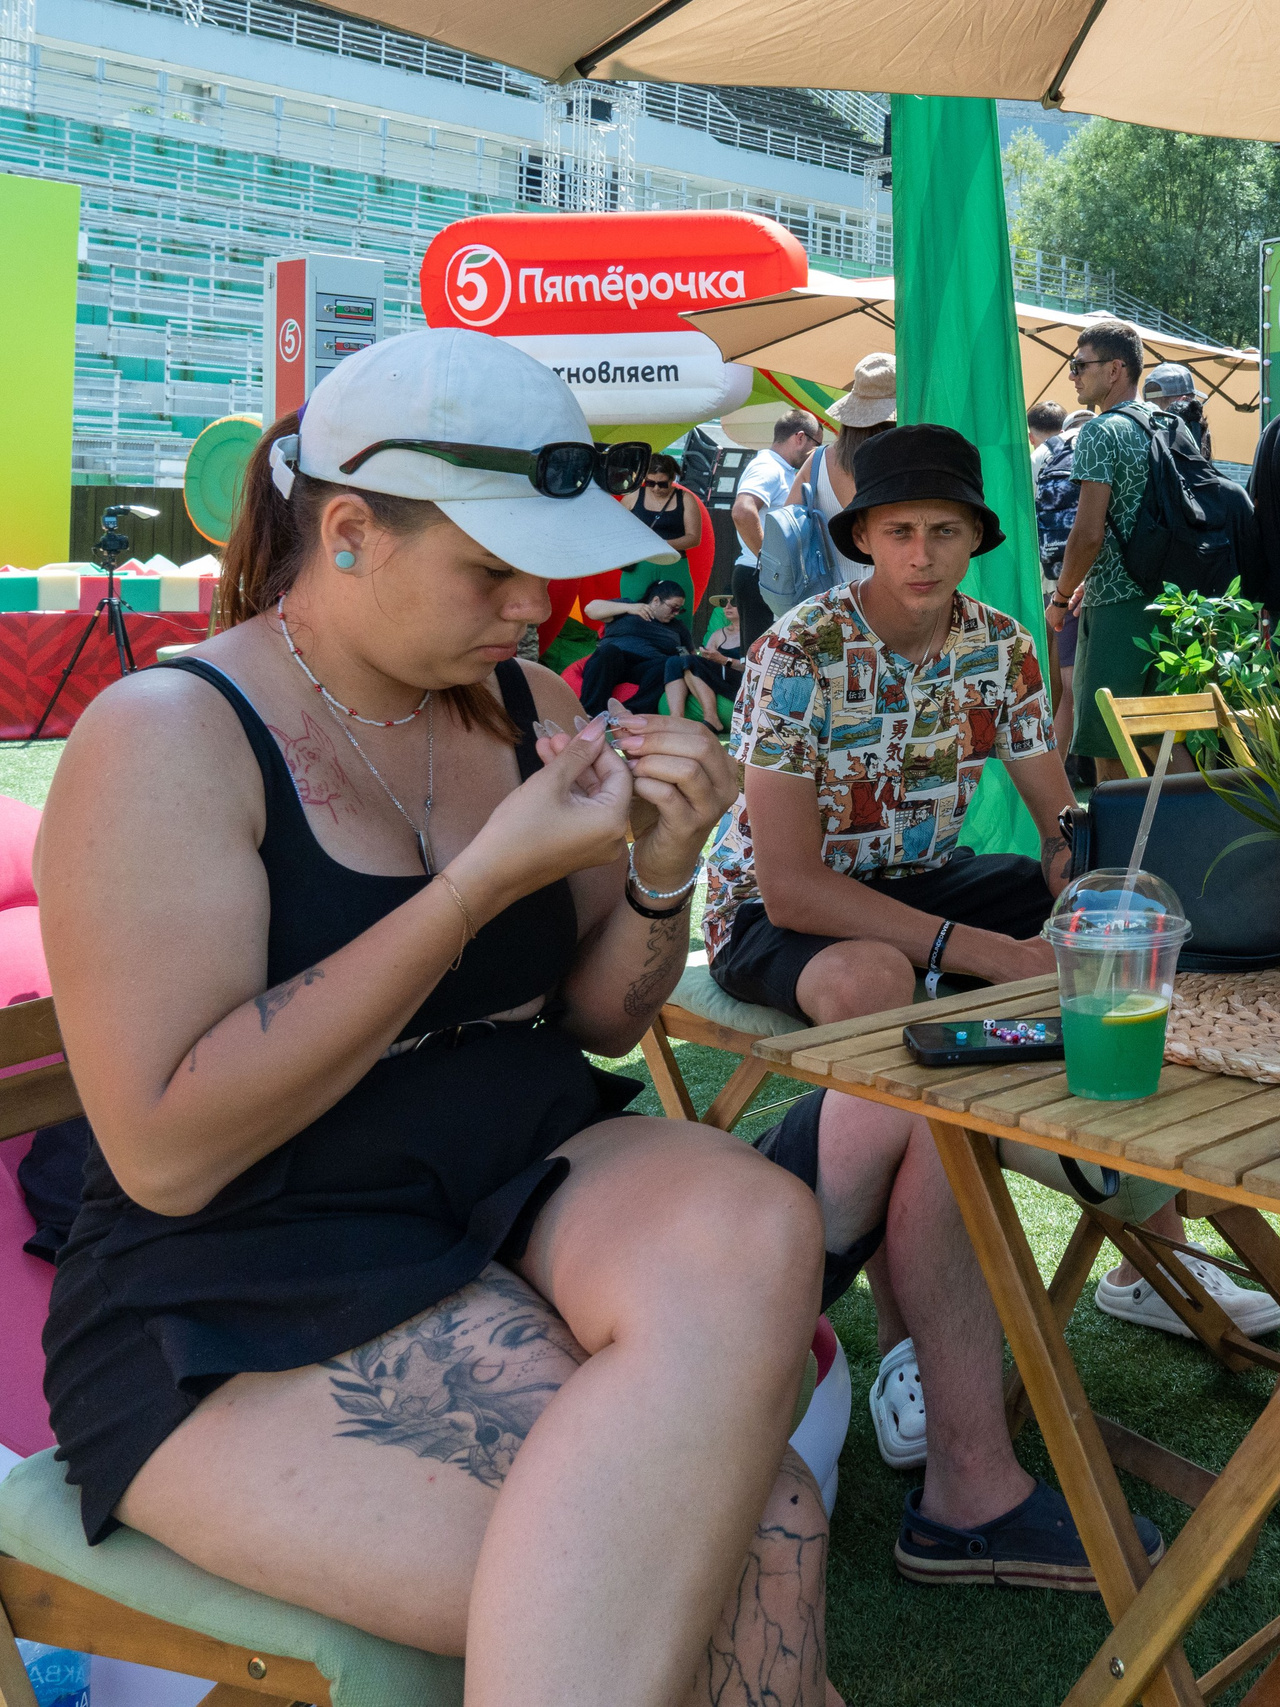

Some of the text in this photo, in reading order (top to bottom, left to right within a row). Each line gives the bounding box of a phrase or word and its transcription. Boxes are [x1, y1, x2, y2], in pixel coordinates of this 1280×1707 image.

[518, 265, 746, 310] Пятёрочка
[552, 361, 680, 384] хновляет
[885, 719, 909, 763] 勇気
